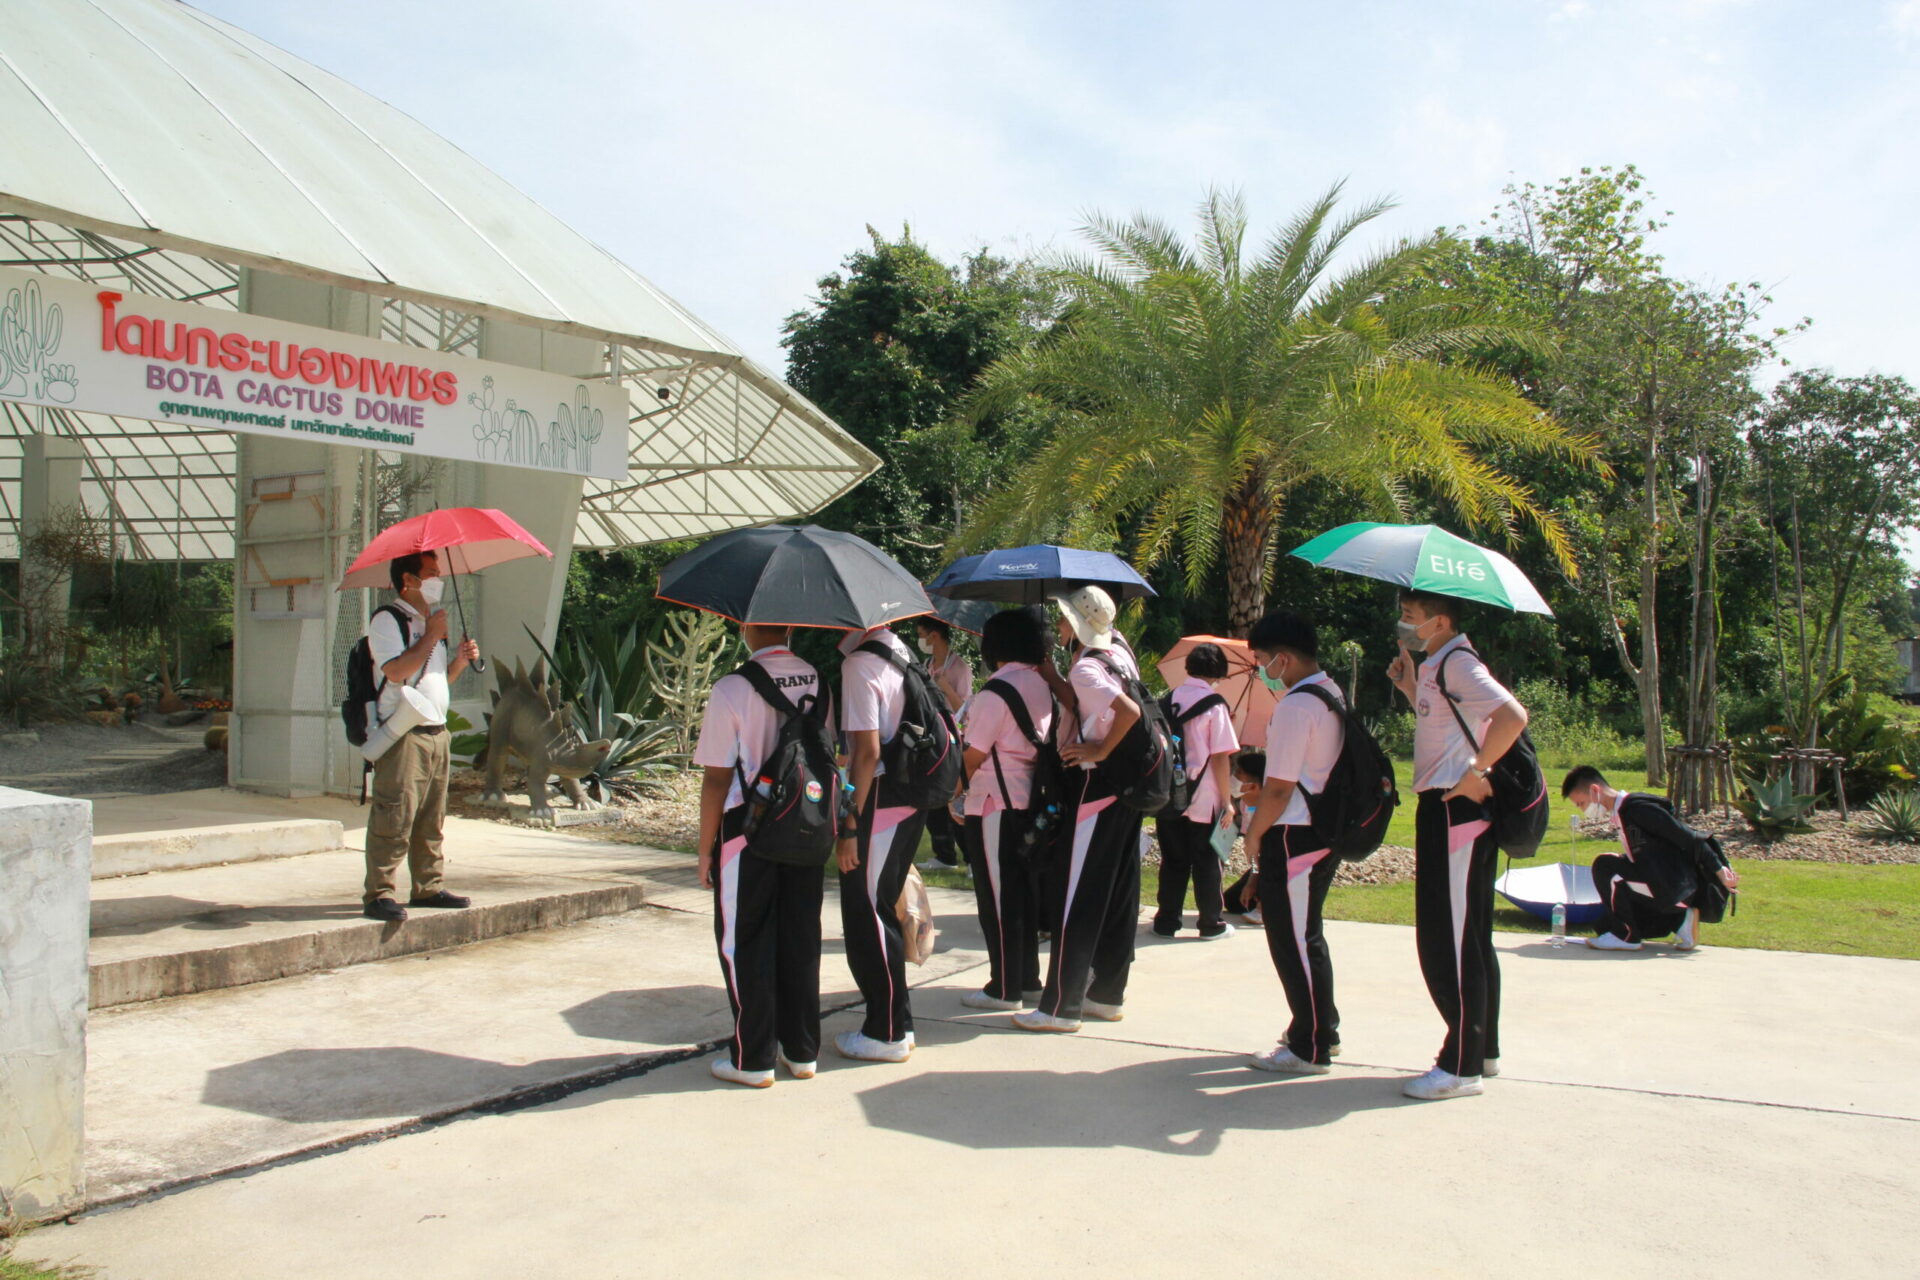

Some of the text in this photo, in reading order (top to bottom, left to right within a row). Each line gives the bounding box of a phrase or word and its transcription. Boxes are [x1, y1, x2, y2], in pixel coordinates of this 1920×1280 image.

[96, 291, 459, 406] โดมกระบองเพชร
[146, 364, 425, 429] BOTA CACTUS DOME
